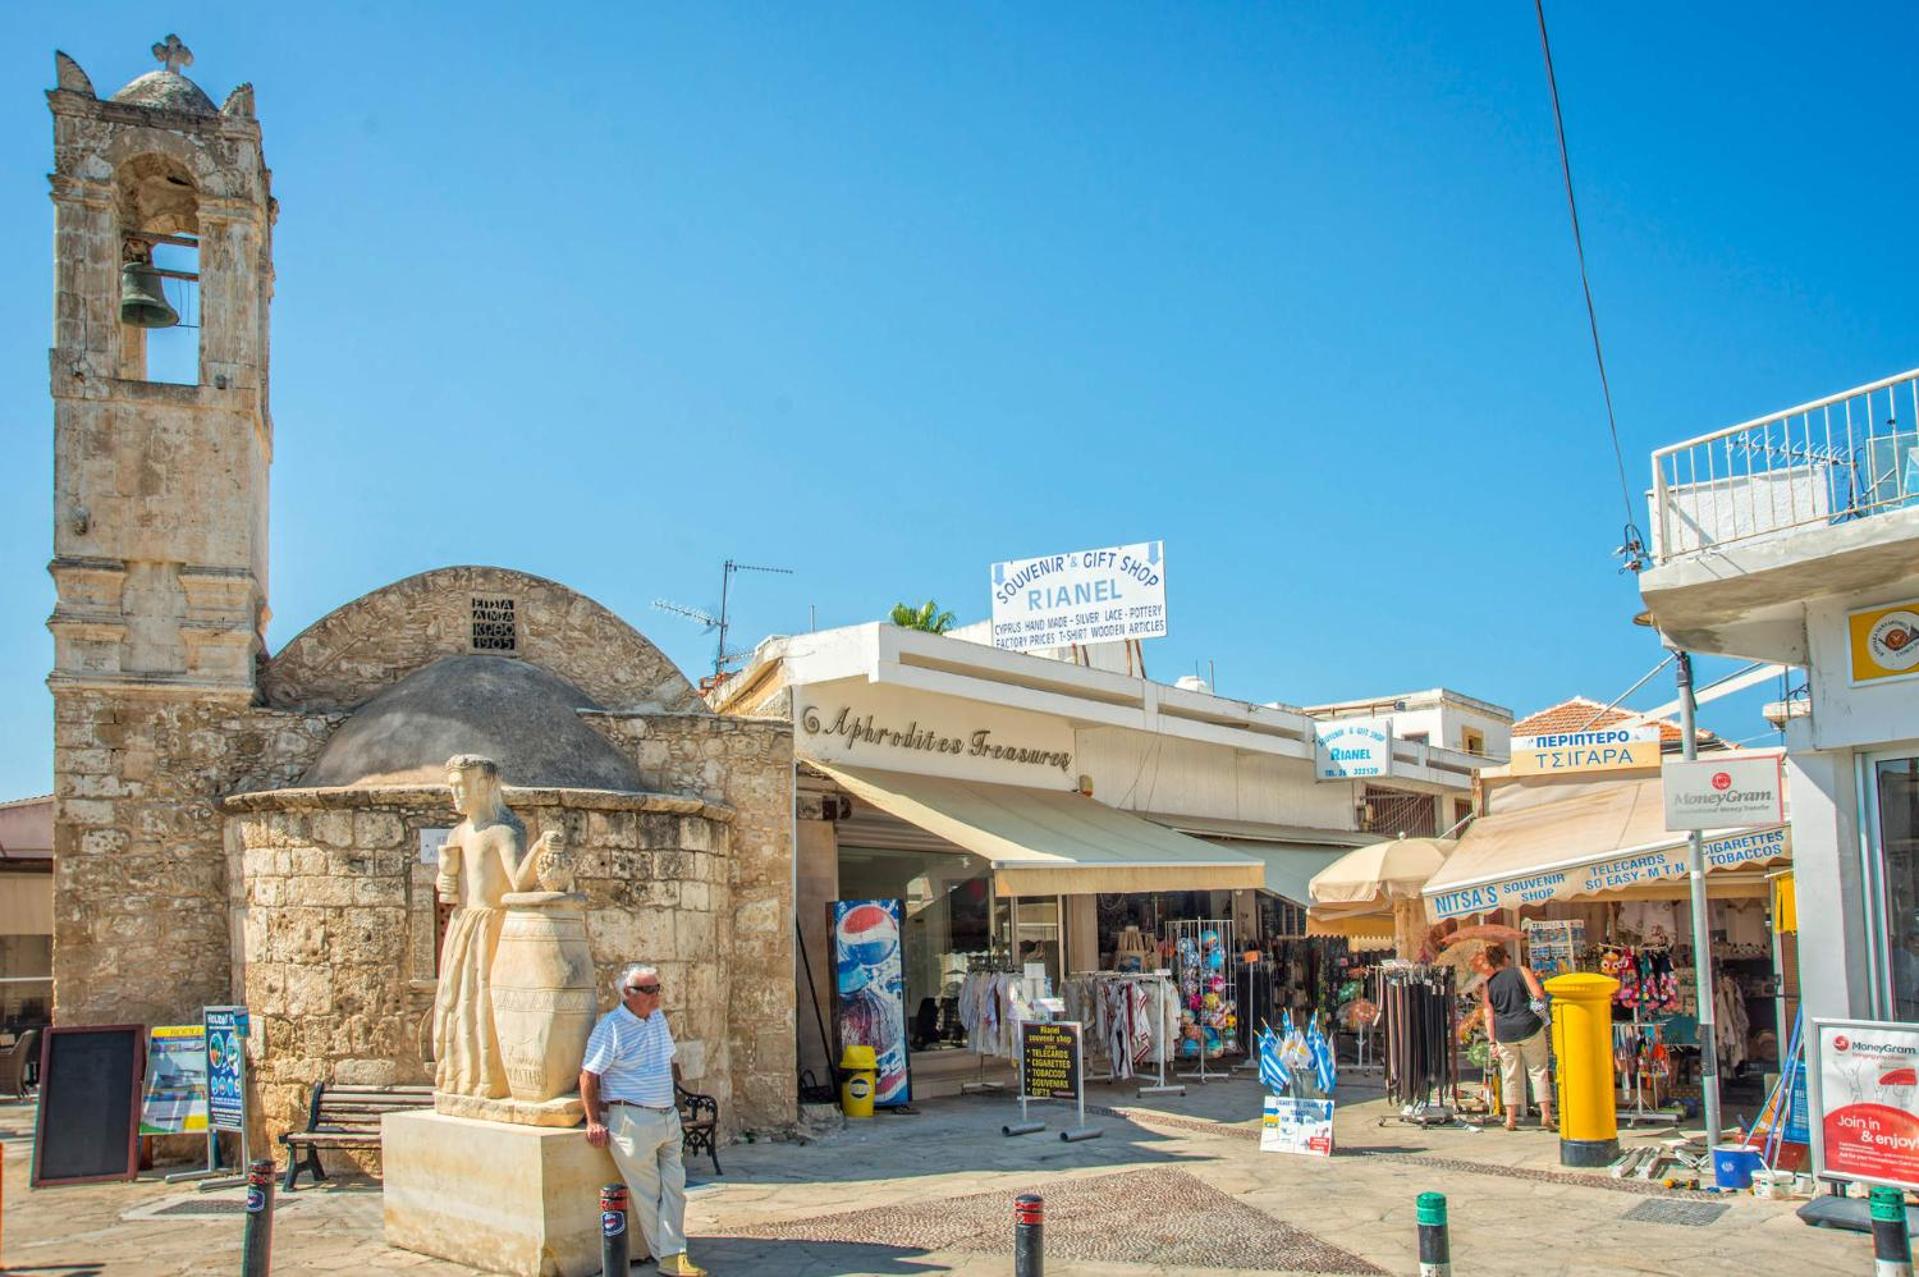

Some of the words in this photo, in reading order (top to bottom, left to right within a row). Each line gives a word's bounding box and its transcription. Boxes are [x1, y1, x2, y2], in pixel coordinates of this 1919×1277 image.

[996, 556, 1064, 605] SOUVENIR
[1070, 557, 1078, 568] &
[1083, 552, 1117, 569] GIFT
[1120, 556, 1159, 587] SHOP
[1028, 578, 1122, 611] RIANEL
[995, 621, 1021, 636] CYPRUS
[1025, 618, 1045, 631] HAND
[1047, 616, 1068, 628] MADE
[1075, 611, 1100, 625] SILVER
[1104, 608, 1123, 621] LACE
[1130, 604, 1162, 619] POTTERY
[996, 635, 1028, 649] FACTORY
[1030, 632, 1055, 646] PRICES
[1059, 627, 1087, 642] T-SHIRT
[1091, 623, 1125, 638] WOODEN
[1129, 619, 1164, 634] ARTICLES
[824, 706, 965, 753] Aphrodites
[969, 729, 1073, 772] Treasures
[1536, 730, 1630, 748] ΠΕΡΙΠΤΕΡΟ
[1331, 748, 1371, 761] RIANEL
[1535, 749, 1634, 769] ΤΣΙΓΑΡΑ
[1701, 831, 1785, 856] CIGARETTES
[1590, 854, 1666, 877] TELECARDS
[1709, 845, 1782, 866] TOBACCOS
[1503, 873, 1565, 894] SOUVENIR
[1585, 879, 1603, 891] SO
[1435, 887, 1498, 913] NITSA'S
[1521, 887, 1555, 902] SHOP
[1032, 1049, 1069, 1058] TELECARDS
[1032, 1059, 1071, 1068] CIGARETTES
[1032, 1069, 1067, 1078] TOBACCOS
[1838, 1115, 1866, 1128] Join
[1868, 1117, 1881, 1130] in
[1860, 1130, 1873, 1142] &
